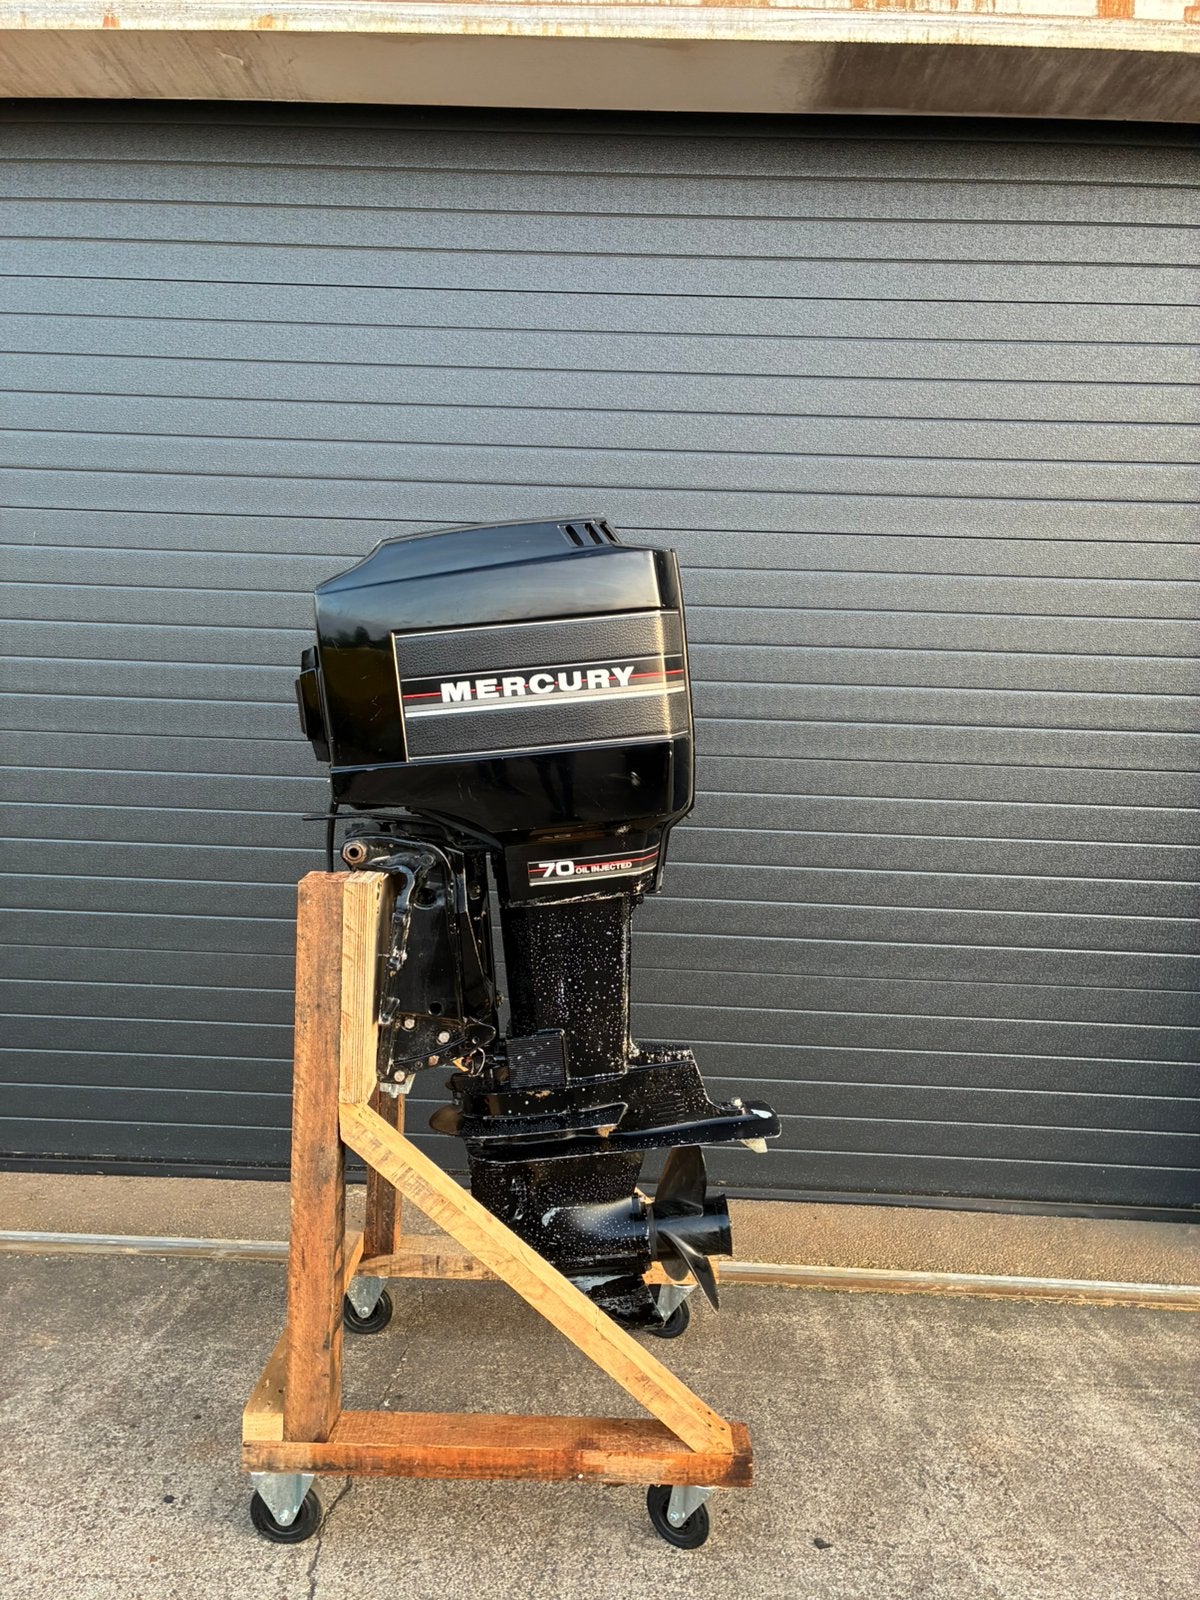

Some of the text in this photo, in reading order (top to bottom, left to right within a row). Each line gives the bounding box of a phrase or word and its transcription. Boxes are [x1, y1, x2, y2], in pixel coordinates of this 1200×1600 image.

[440, 666, 634, 703] MERCURY
[538, 861, 633, 878] 70 OIL INJECTED
